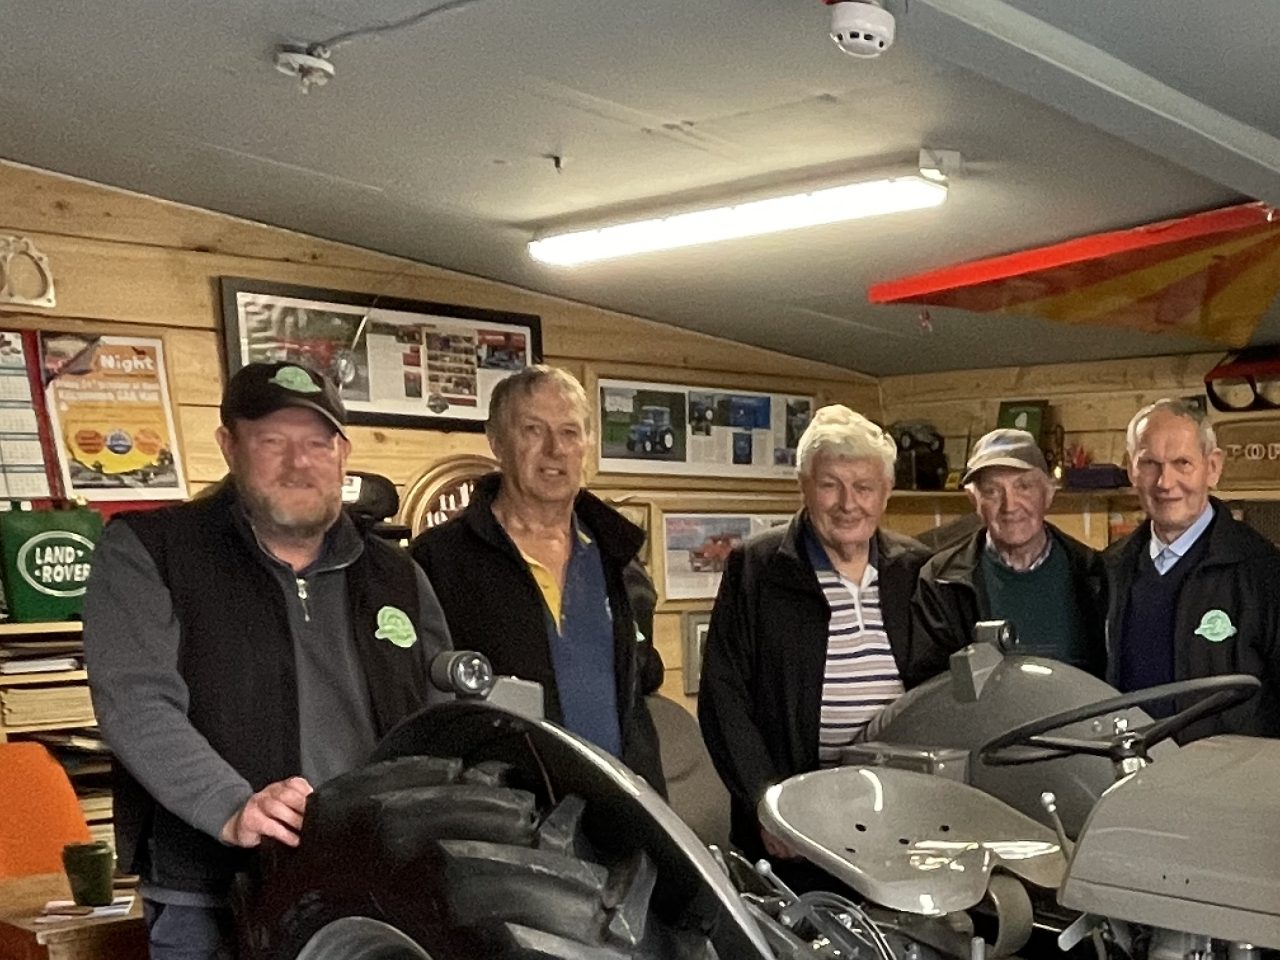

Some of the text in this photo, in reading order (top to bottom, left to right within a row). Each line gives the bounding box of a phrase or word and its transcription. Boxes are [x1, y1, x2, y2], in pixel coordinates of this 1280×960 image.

[99, 353, 155, 373] Night
[35, 545, 76, 565] LAND
[42, 563, 91, 583] ROVER
